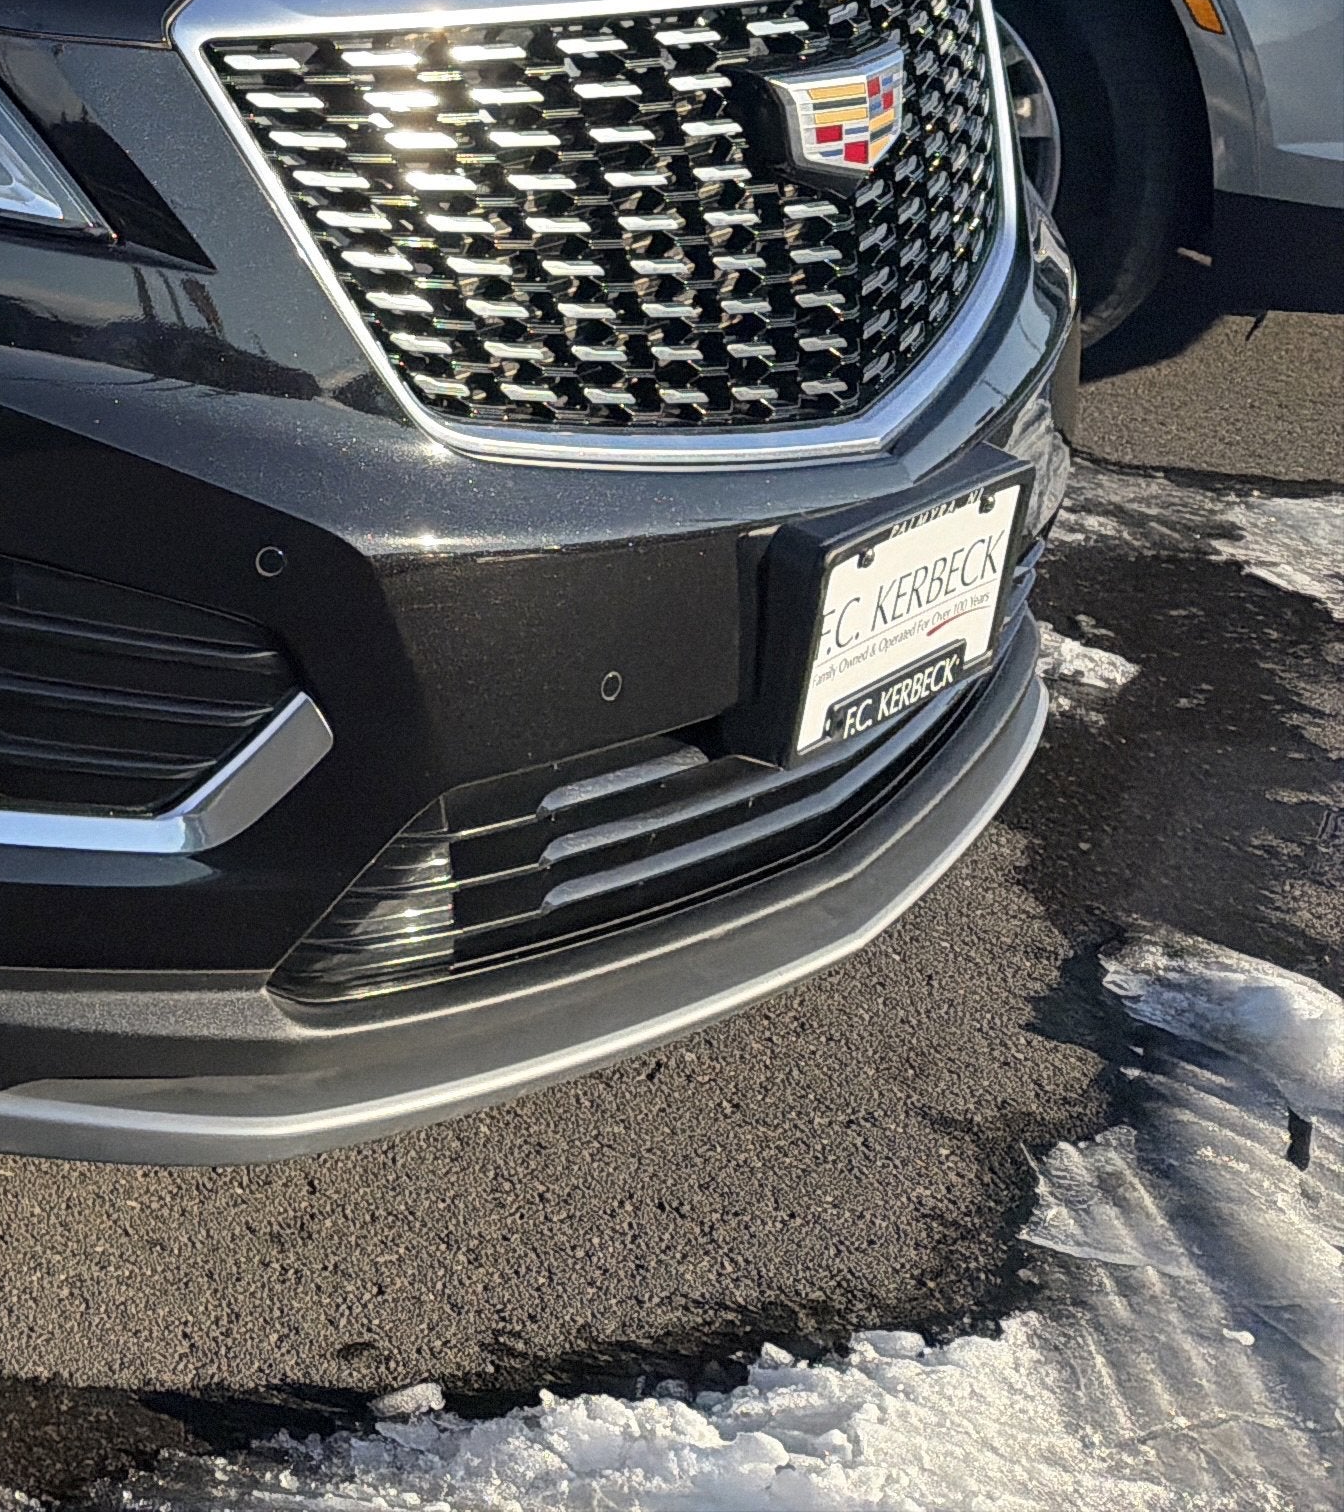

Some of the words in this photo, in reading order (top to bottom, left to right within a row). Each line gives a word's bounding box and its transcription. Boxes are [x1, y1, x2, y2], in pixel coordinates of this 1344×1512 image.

[871, 529, 1005, 633] KERBECK
[812, 663, 836, 689] Family
[839, 644, 870, 674] Owned
[877, 621, 917, 653] Operated
[917, 618, 931, 635] For
[932, 608, 952, 626] Over
[953, 598, 968, 616] 100
[970, 591, 991, 607] Years
[842, 698, 873, 739] F.C.
[877, 653, 958, 722] KERBECK
